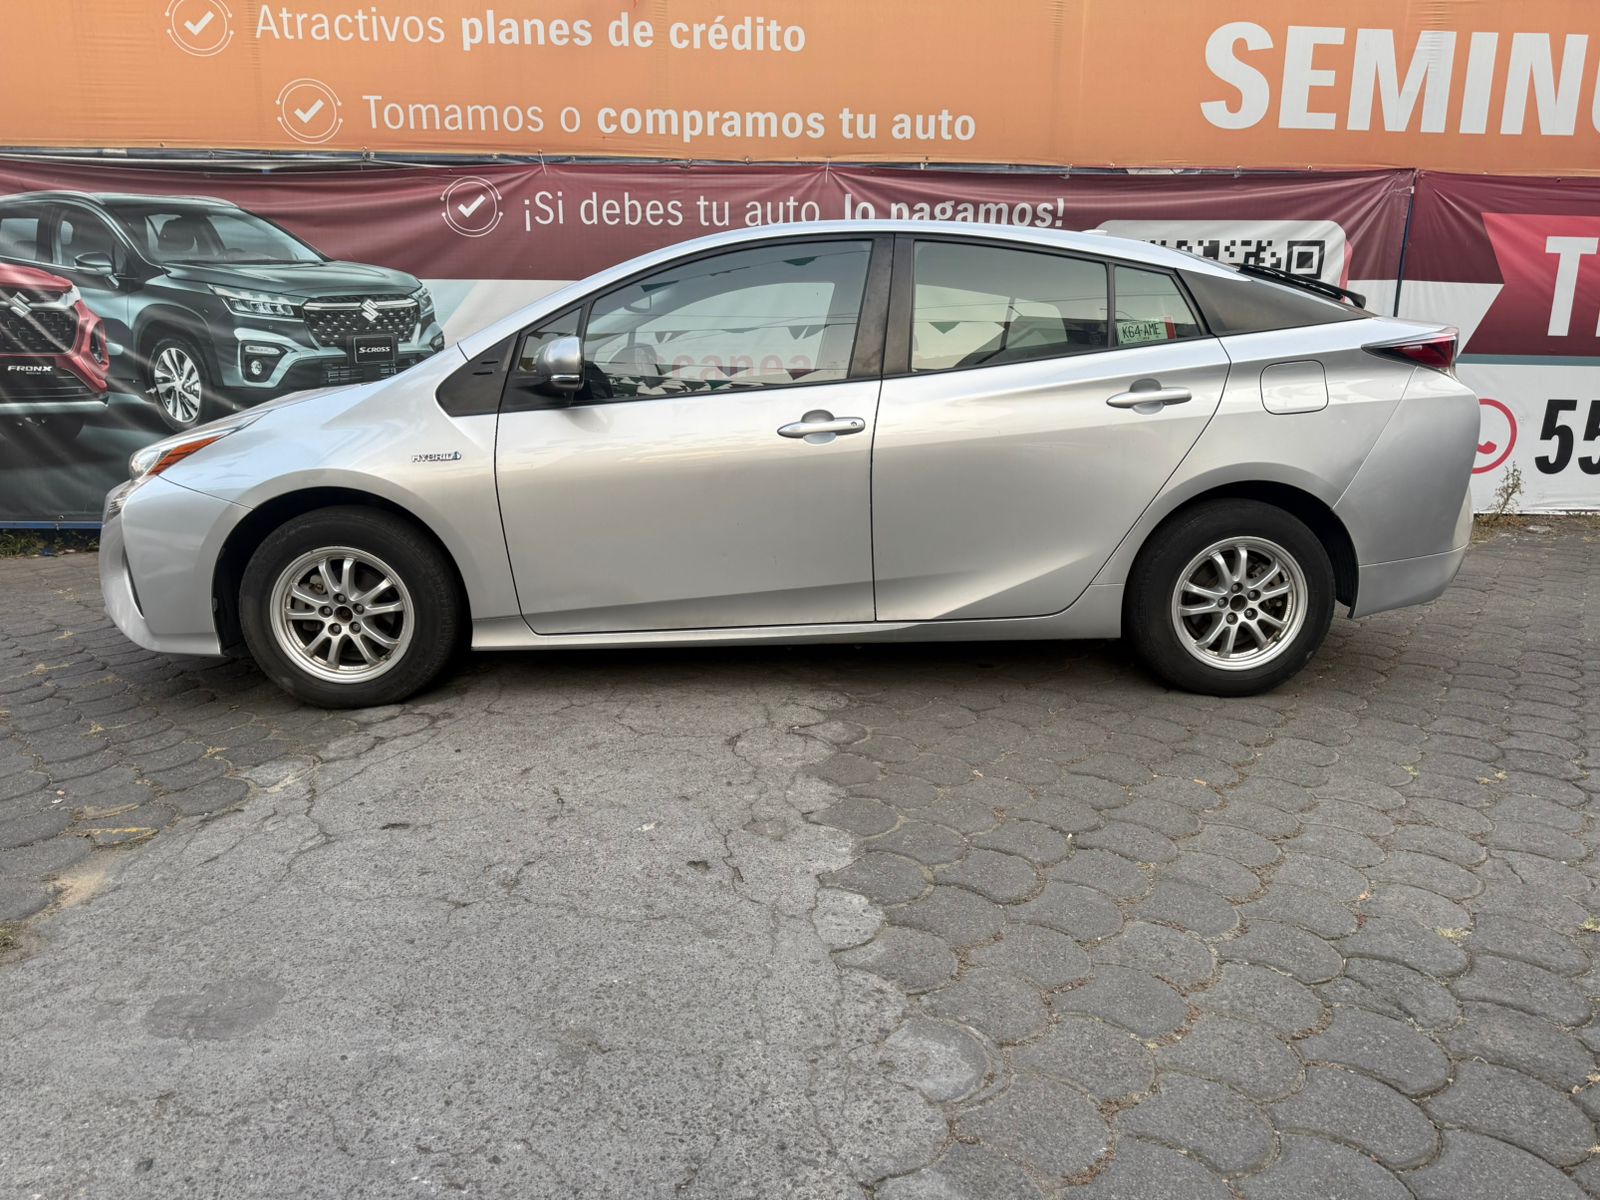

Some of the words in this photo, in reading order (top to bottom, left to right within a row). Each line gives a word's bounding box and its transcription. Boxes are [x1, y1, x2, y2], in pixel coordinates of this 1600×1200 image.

[255, 5, 446, 43] Atractivos
[461, 9, 594, 52] planes
[608, 12, 654, 48] de
[669, 16, 806, 52] crédito
[1200, 21, 1600, 136] SEMIN
[362, 95, 544, 132] Tomamos
[560, 107, 581, 133] o
[597, 106, 825, 143] compramos
[839, 107, 876, 139] tu
[891, 109, 976, 141] auto
[524, 190, 564, 231] ¡Si
[579, 192, 683, 226] debes
[697, 196, 730, 226] tu
[844, 193, 875, 220] lo
[1545, 236, 1600, 337] T
[1122, 322, 1161, 339] K64-AME
